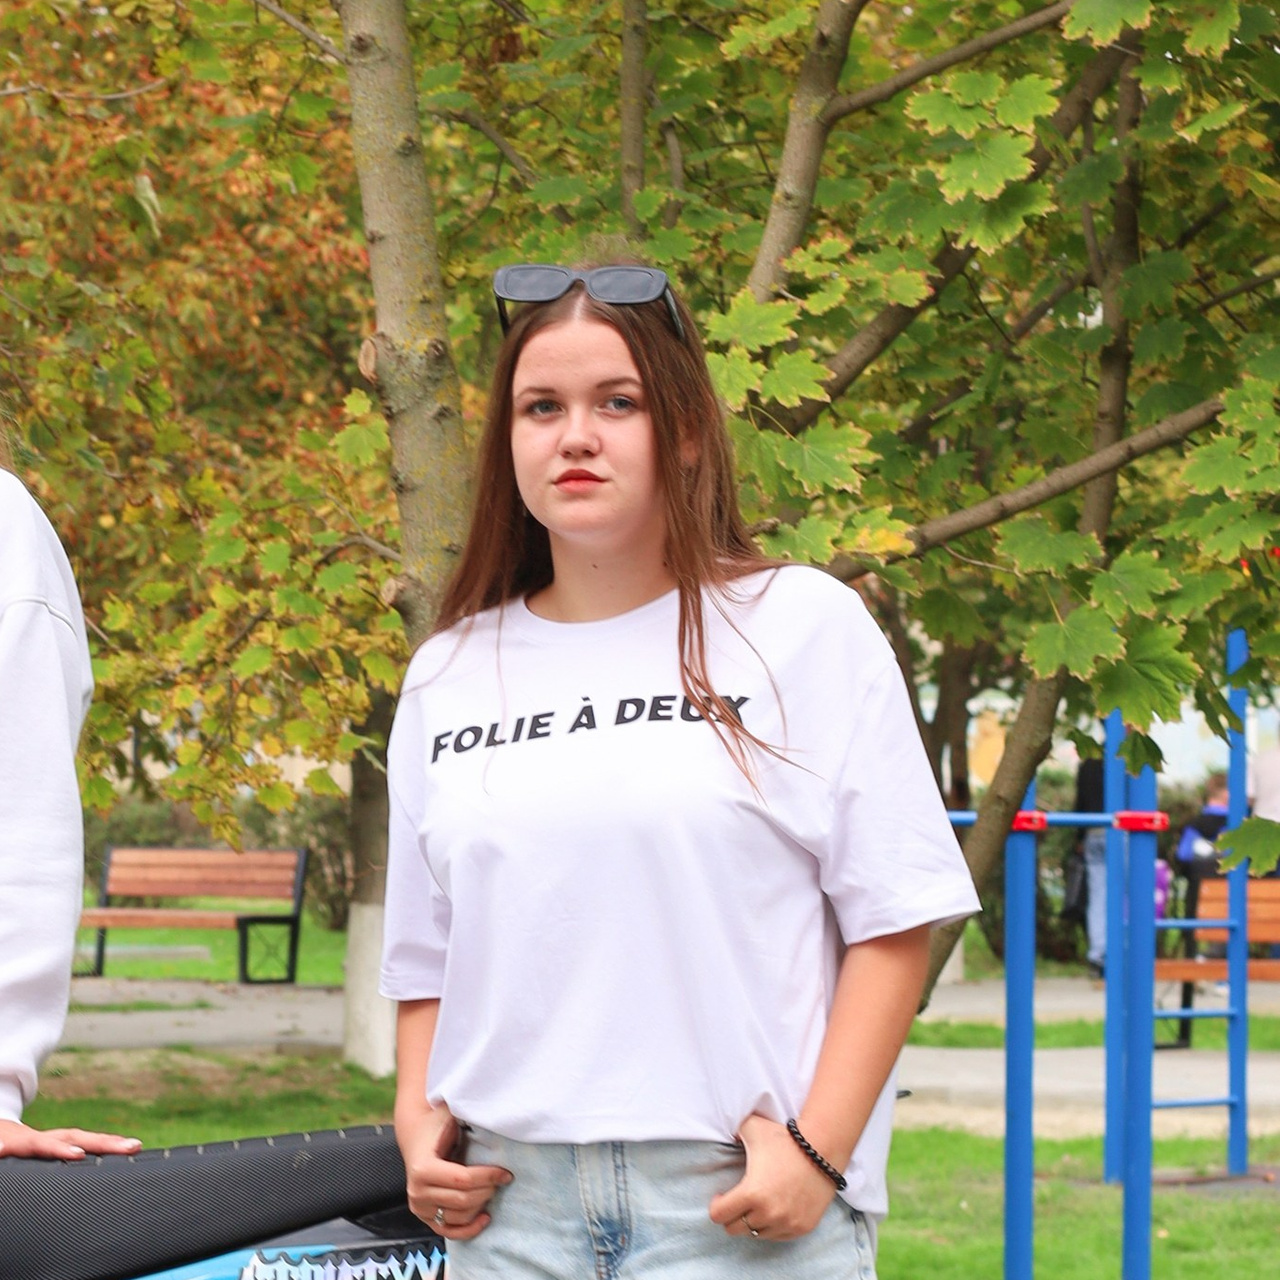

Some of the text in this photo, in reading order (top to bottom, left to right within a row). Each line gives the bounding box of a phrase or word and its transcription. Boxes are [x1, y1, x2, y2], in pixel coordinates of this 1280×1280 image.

[431, 694, 751, 764] FOLIE À DEUX
